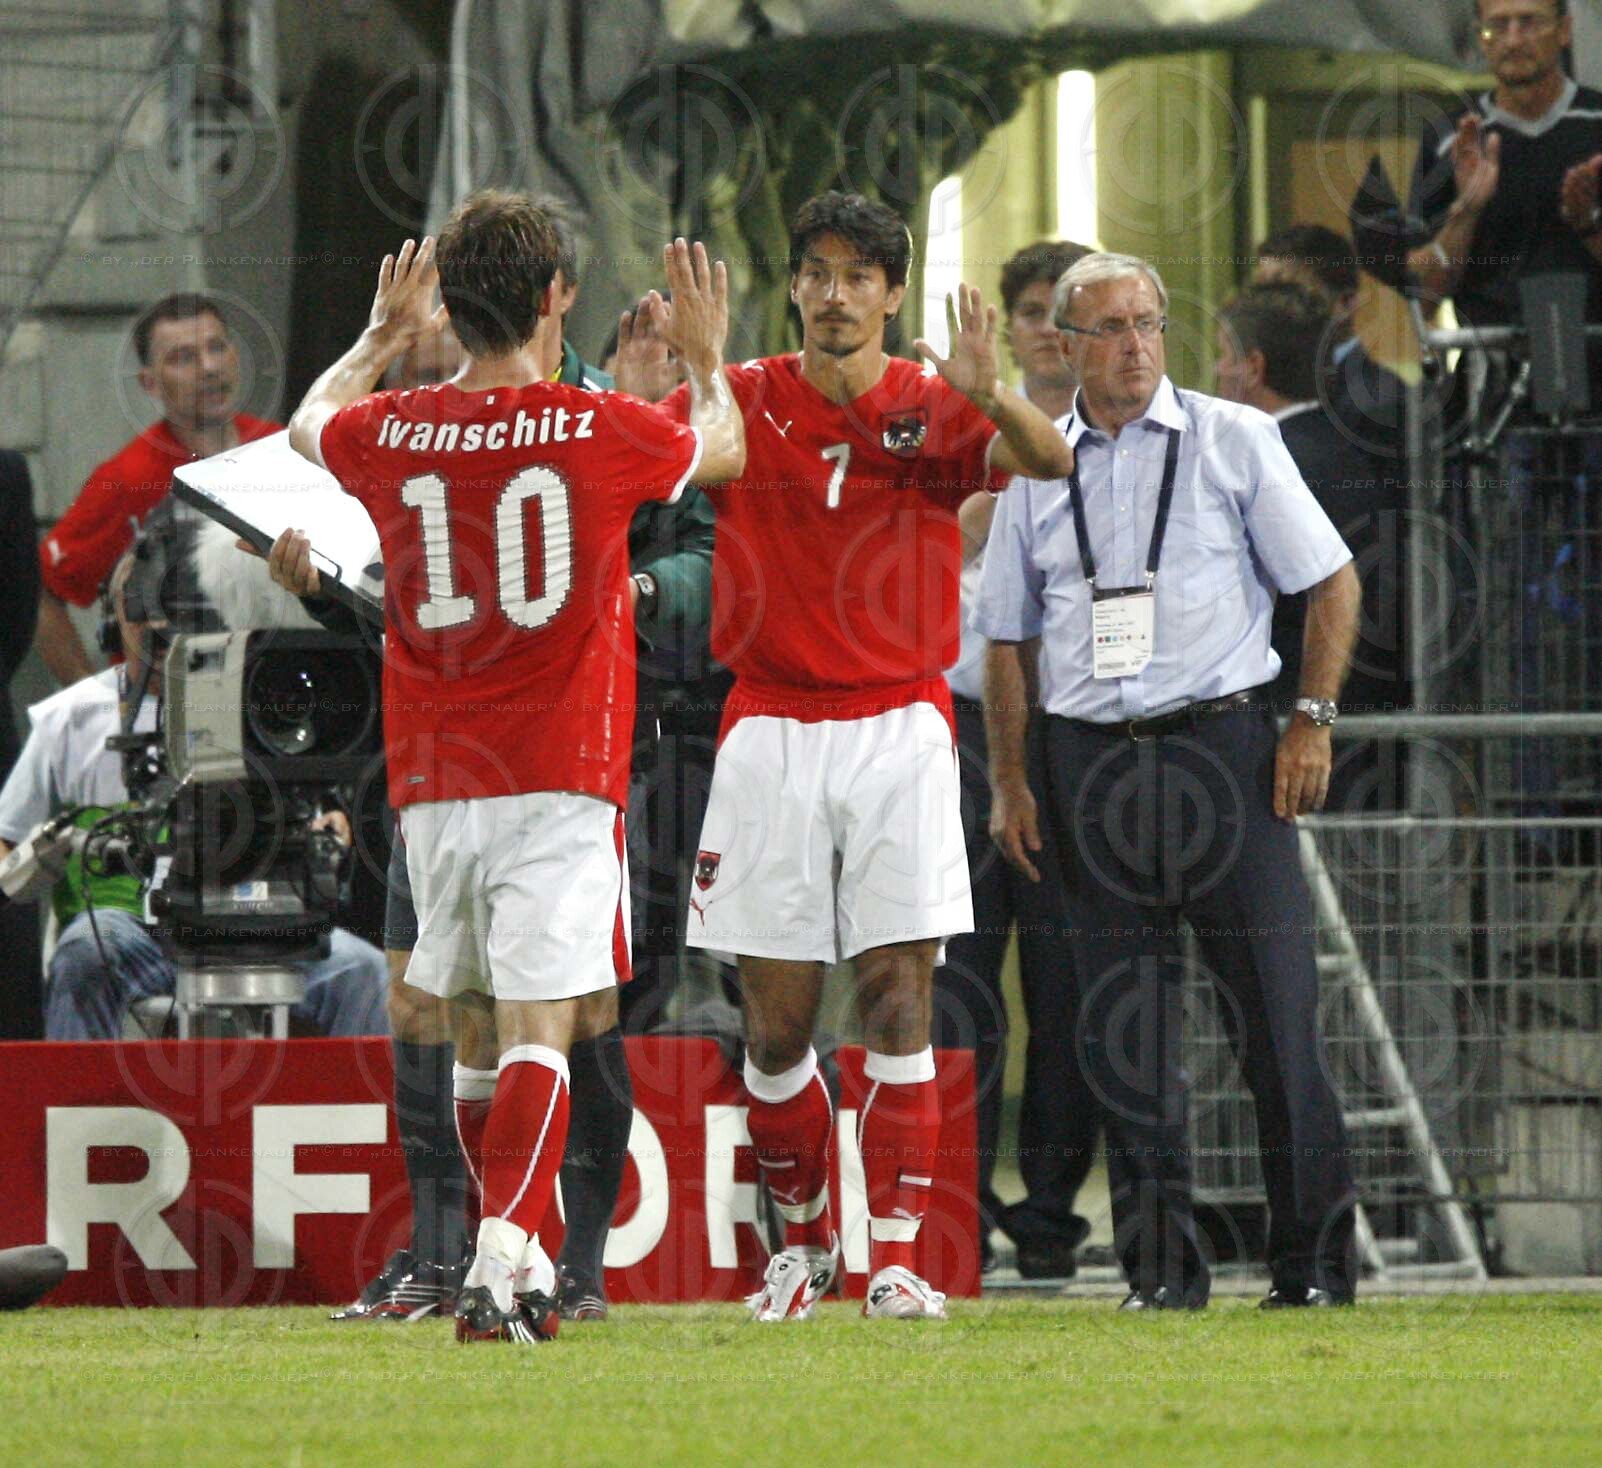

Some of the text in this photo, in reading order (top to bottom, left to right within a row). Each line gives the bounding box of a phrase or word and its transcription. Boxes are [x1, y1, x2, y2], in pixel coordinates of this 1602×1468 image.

[377, 407, 595, 452] ivanschitz
[821, 443, 851, 508] 7
[401, 465, 572, 630] 10
